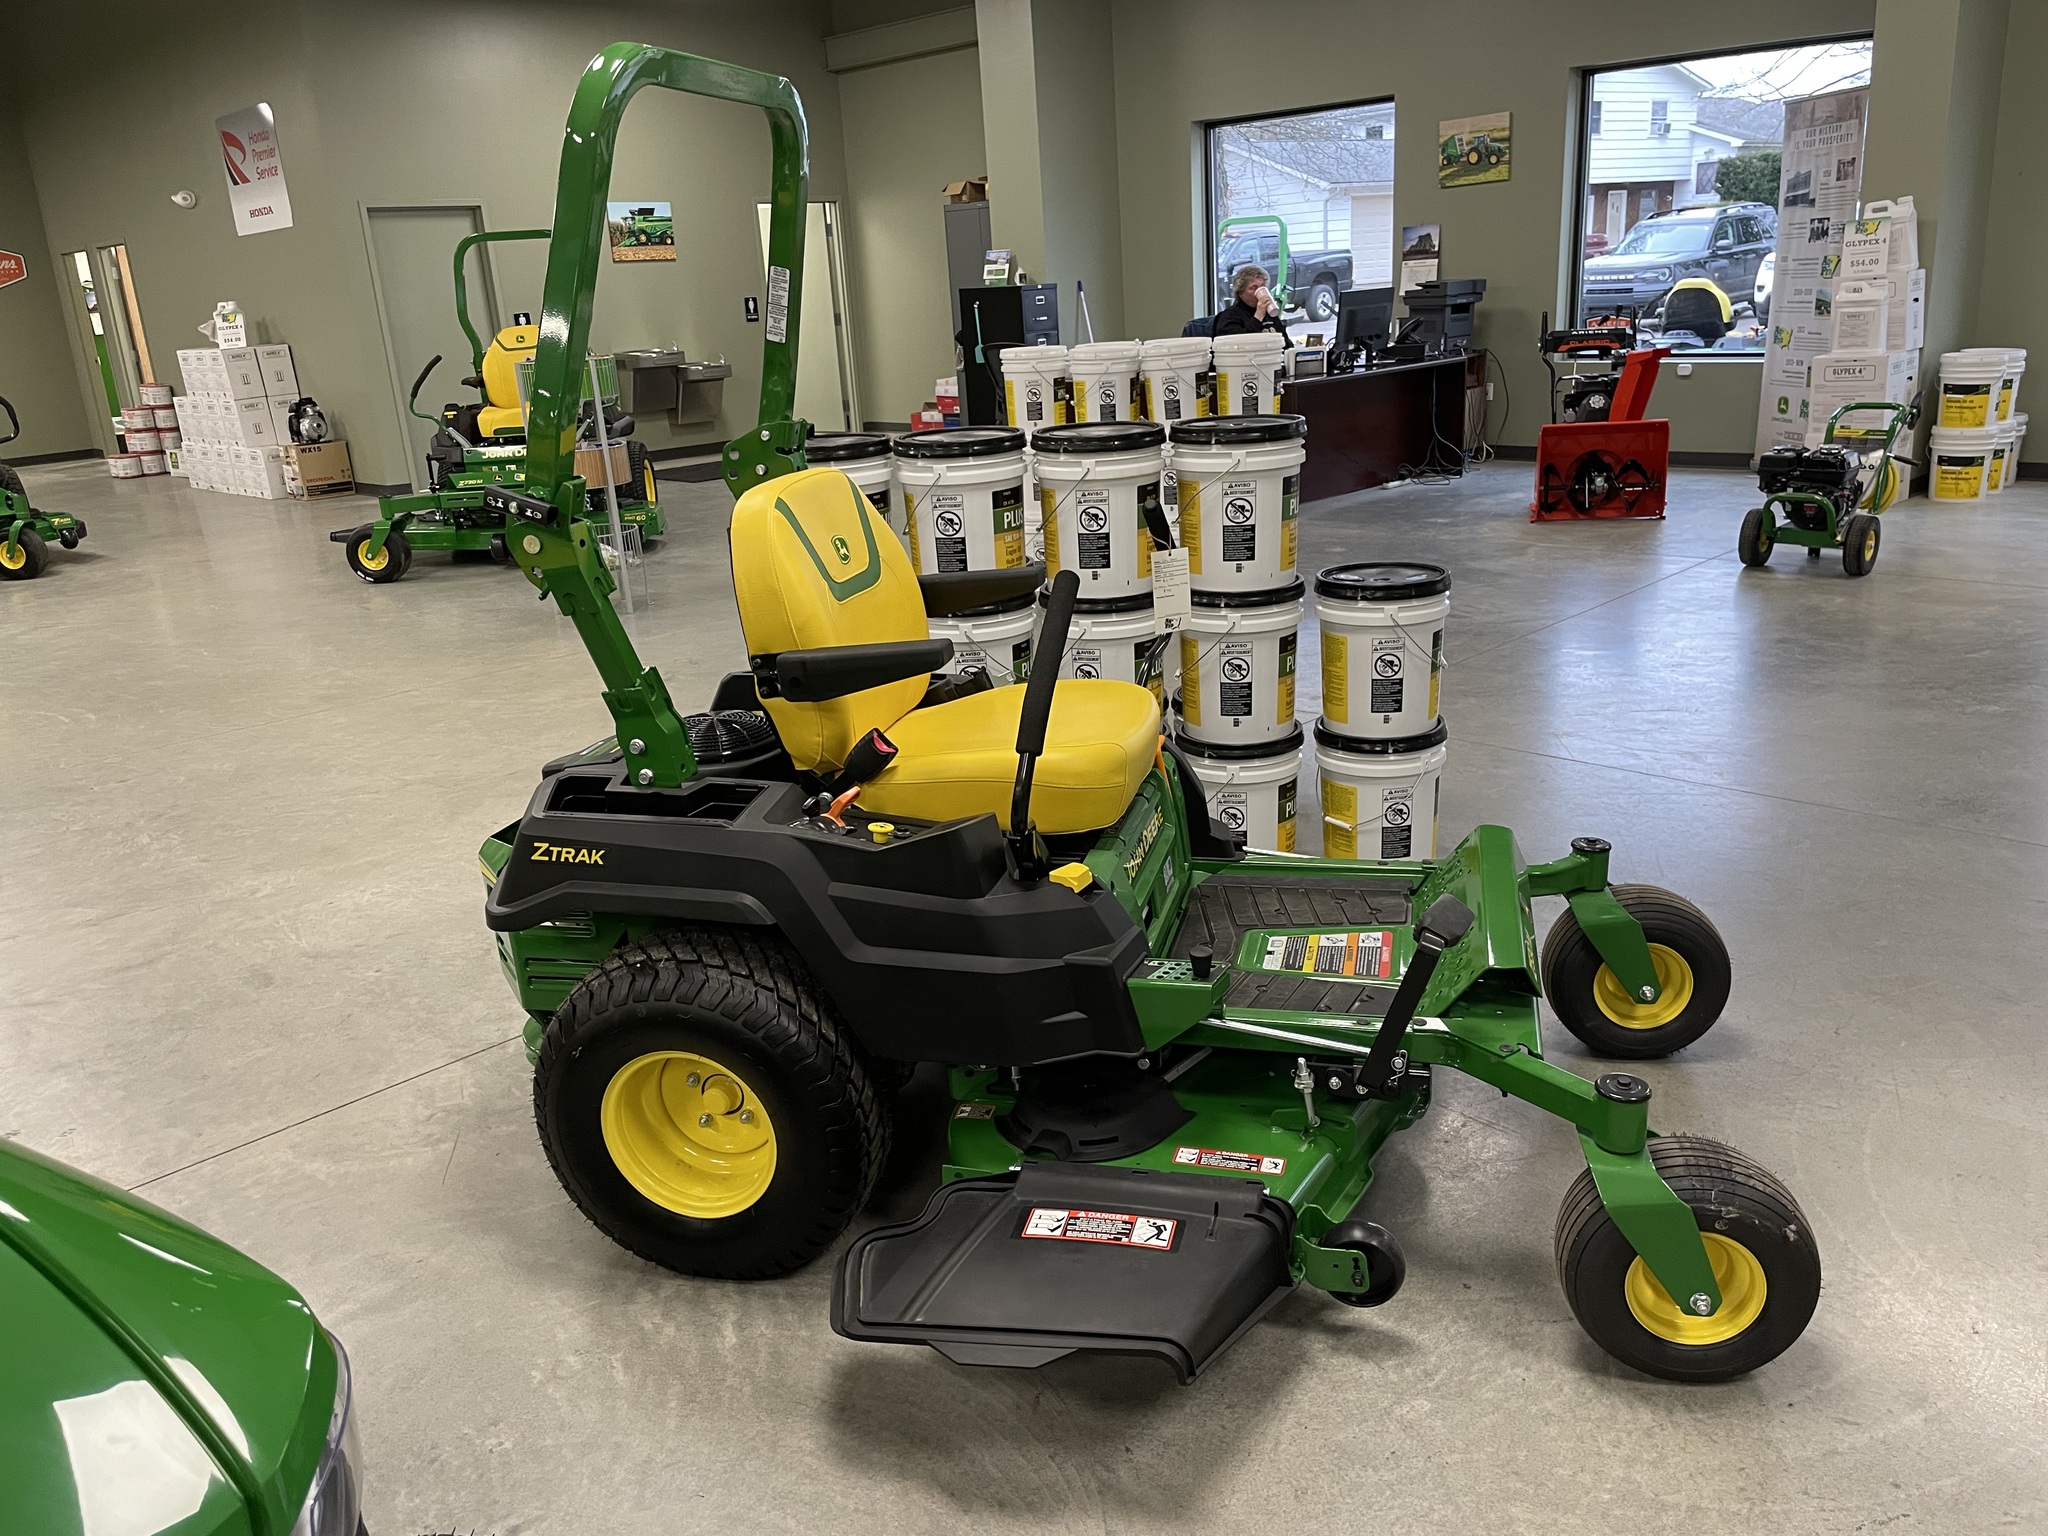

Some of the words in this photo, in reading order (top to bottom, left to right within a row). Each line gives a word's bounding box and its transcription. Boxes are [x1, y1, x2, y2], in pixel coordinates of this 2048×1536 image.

[248, 129, 270, 145] Honda
[1806, 128, 1816, 138] OUR
[1818, 124, 1842, 136] HISTORY
[1794, 141, 1800, 150] IS
[1802, 138, 1816, 149] YOUR
[1818, 133, 1854, 146] PROSPERITY
[252, 145, 276, 162] Premier
[256, 164, 278, 180] Service
[249, 206, 274, 218] HONDA
[1845, 238, 1880, 248] GLYPEX
[1850, 258, 1879, 268] $54.00
[1832, 368, 1856, 376] GLYPEX
[300, 446, 322, 454] WX15
[482, 450, 513, 459] JOHN
[1123, 842, 1145, 885] JOHN
[1143, 806, 1163, 851] DEERE
[531, 842, 606, 865] ZTRAK
[1088, 1212, 1130, 1221] DANGER
